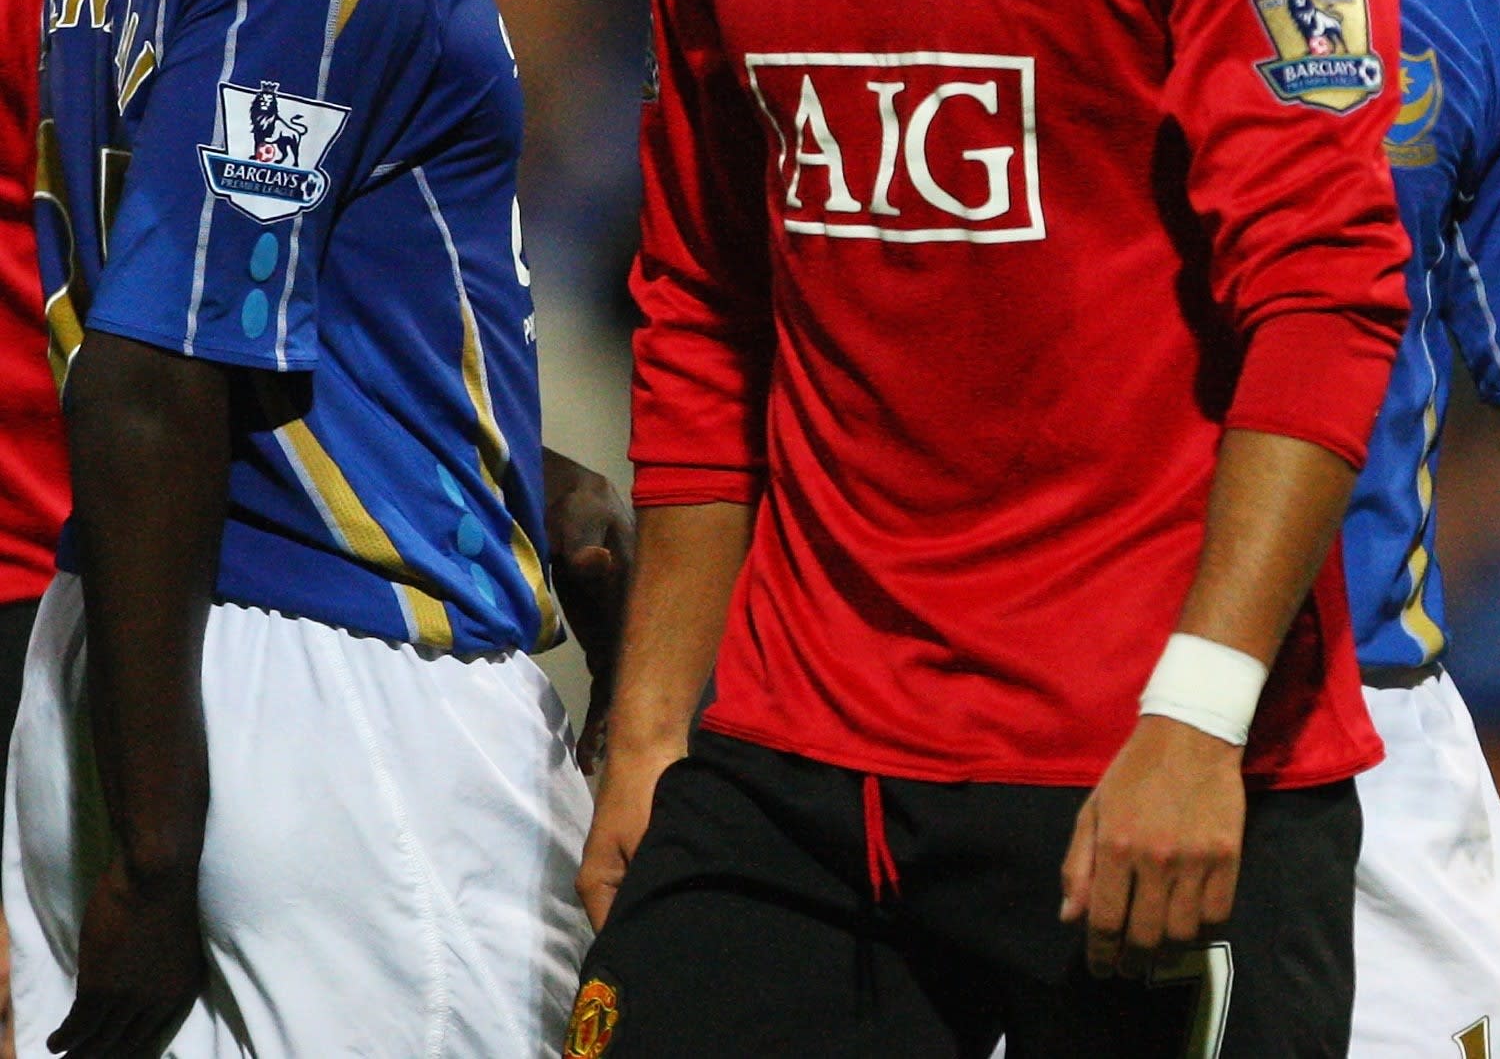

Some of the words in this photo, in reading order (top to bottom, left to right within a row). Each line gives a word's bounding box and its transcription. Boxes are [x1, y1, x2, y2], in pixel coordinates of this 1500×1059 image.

[1285, 61, 1357, 82] BARCLAYS
[786, 74, 1014, 221] AIG
[223, 163, 299, 188] BARCLAYS
